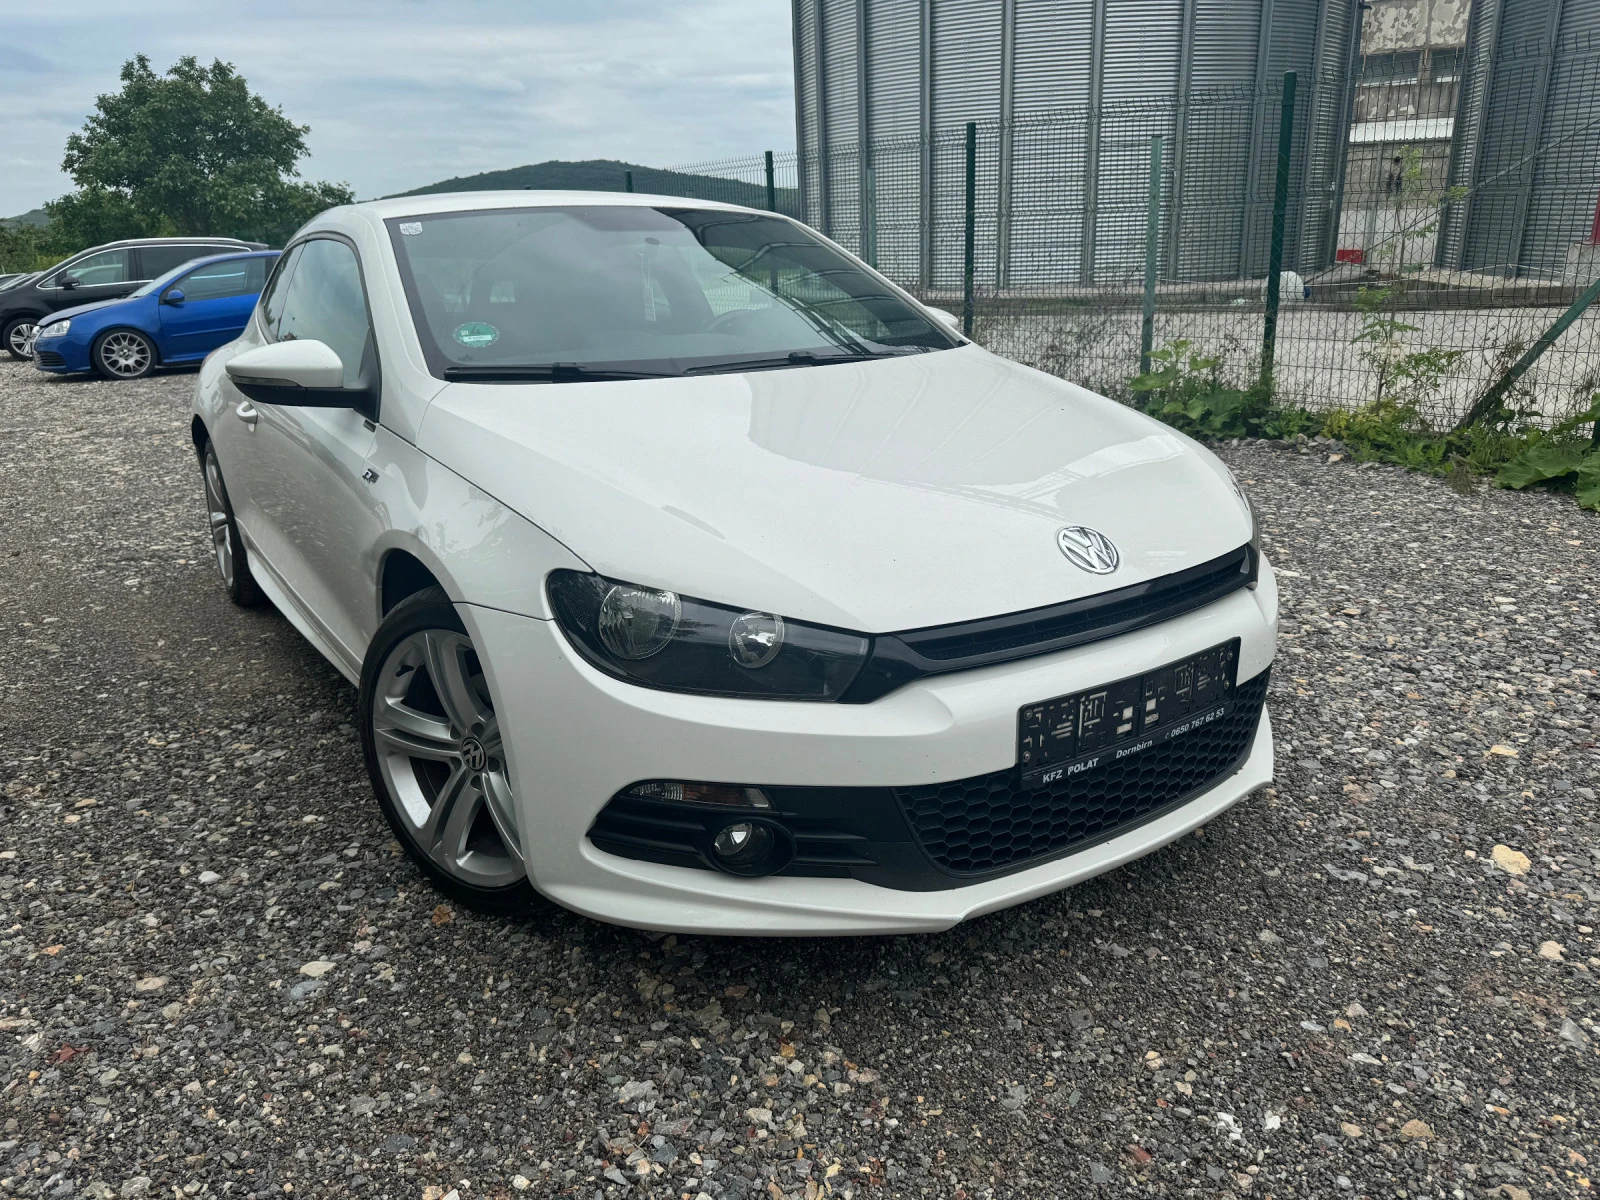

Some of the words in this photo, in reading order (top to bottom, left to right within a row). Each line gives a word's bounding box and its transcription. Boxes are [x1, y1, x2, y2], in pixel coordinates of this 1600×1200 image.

[1042, 769, 1063, 784] KFZ
[1067, 757, 1099, 776] POLAT
[1115, 740, 1153, 759] Dornbirn
[1170, 723, 1189, 738] 0650
[1191, 716, 1205, 729] 767
[1205, 712, 1215, 723] 62
[1215, 707, 1225, 718] 53
